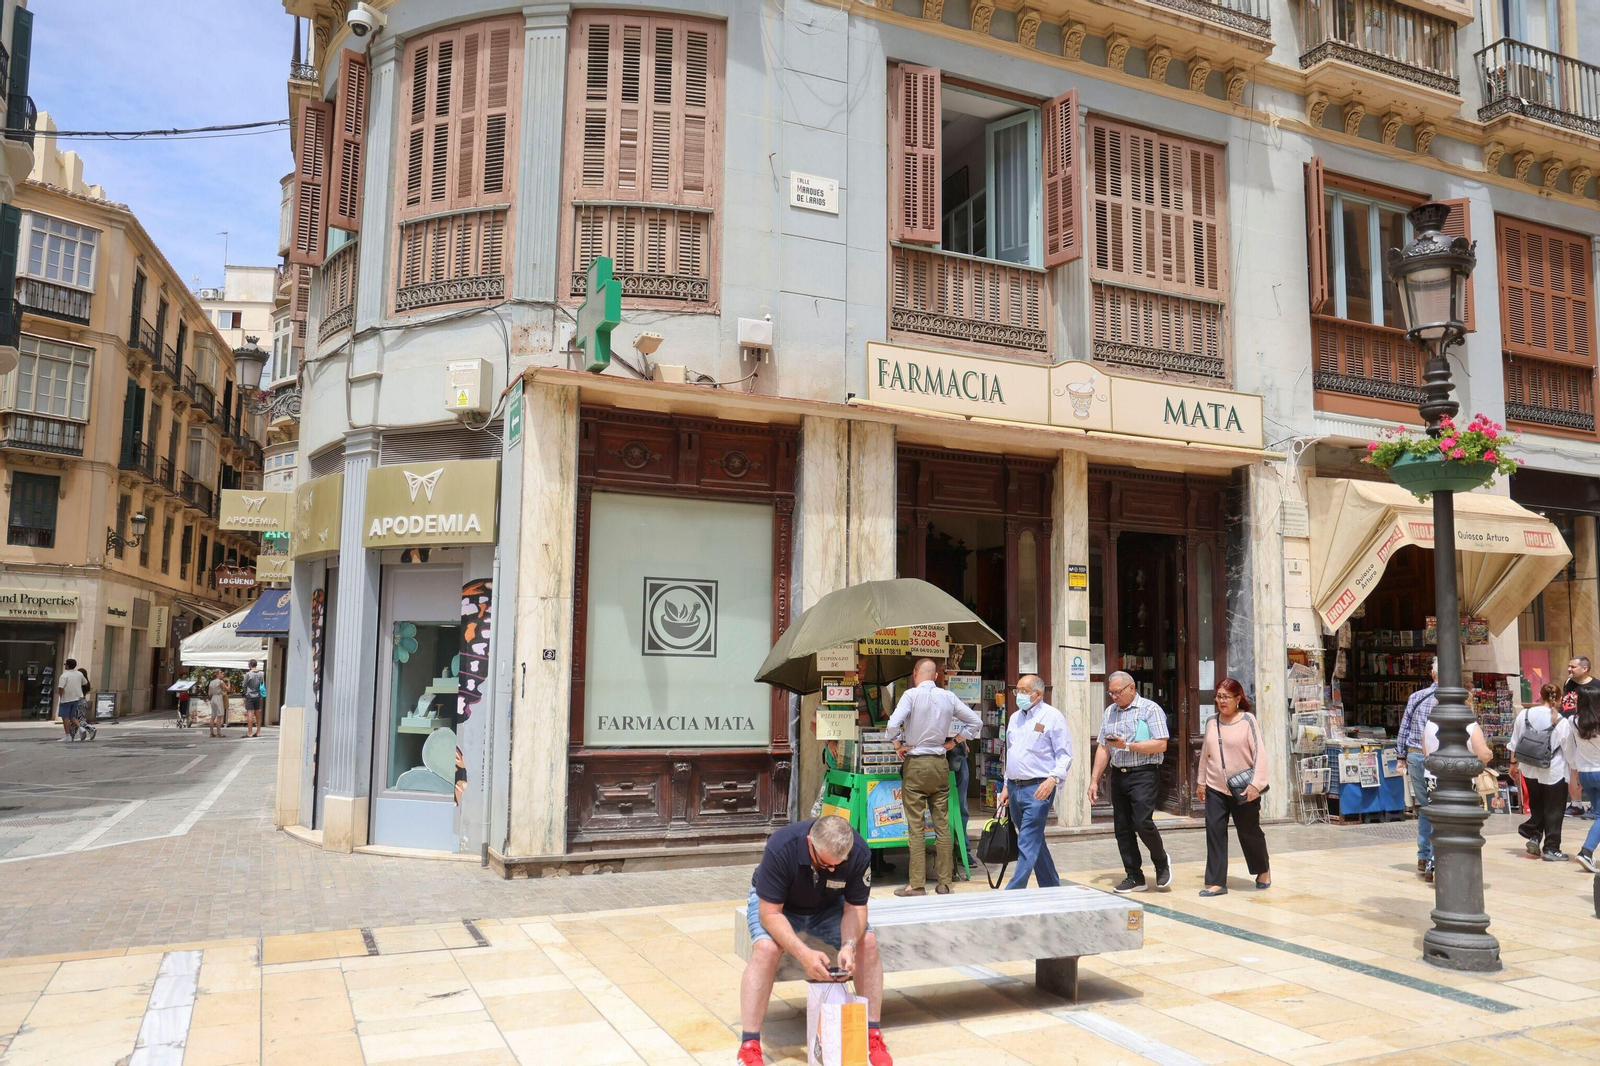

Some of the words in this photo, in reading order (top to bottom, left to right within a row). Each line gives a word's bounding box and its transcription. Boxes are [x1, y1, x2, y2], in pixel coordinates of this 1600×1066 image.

[797, 194, 804, 203] DE
[806, 195, 826, 206] LARIOS
[877, 357, 1006, 405] FARMACIA
[1163, 396, 1245, 433] MATA
[226, 516, 278, 526] APODEMIA
[369, 513, 481, 537] APODEMIA
[1458, 531, 1484, 541] Quiosco
[1487, 533, 1510, 542] Arturo
[1525, 531, 1554, 548] ¡HOLA!
[1355, 563, 1375, 586] Quiosco
[1361, 570, 1377, 590] Arturo
[1327, 589, 1355, 624] ¡HOLA!
[912, 630, 937, 639] 42.248
[875, 638, 890, 646] RASCA
[909, 638, 941, 647] 35.000€
[597, 715, 700, 731] FARMACIA
[704, 716, 755, 731] MATA
[827, 729, 842, 737] 513
